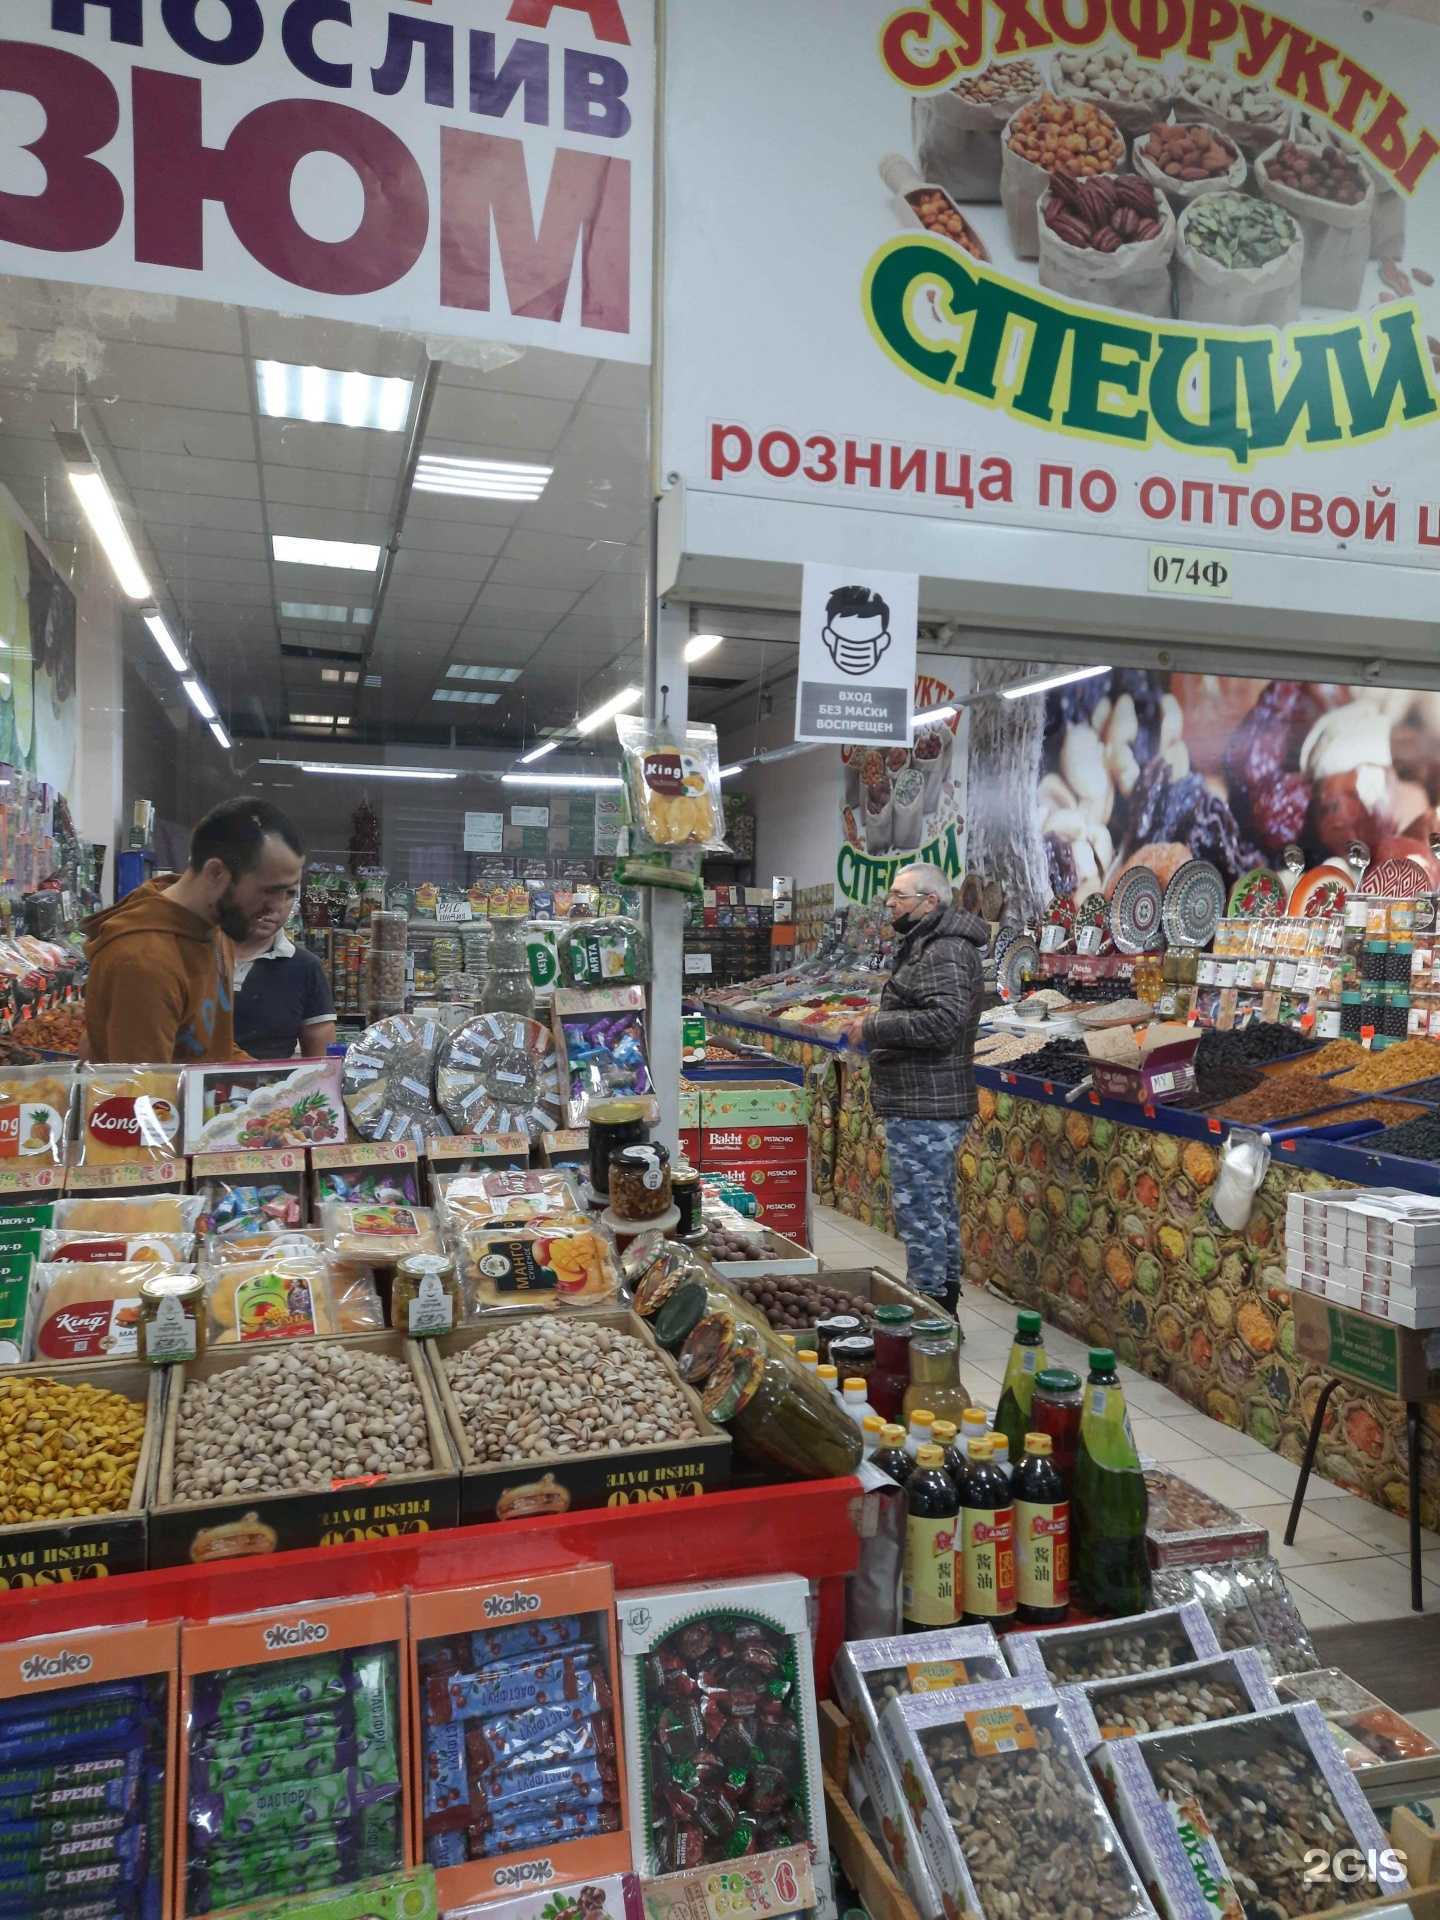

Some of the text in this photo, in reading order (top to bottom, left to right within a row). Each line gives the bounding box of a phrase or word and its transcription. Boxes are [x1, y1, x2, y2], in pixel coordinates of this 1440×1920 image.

[884, 0, 1440, 188] СУХОФРУКТЫ
[870, 244, 1438, 464] СПЕЦИИ
[709, 421, 1013, 510] розница
[1039, 464, 1117, 514] по
[1138, 476, 1397, 543] оптовой
[1153, 556, 1228, 588] 074Ф
[839, 691, 873, 704] ВХОД
[818, 704, 888, 718] БЕЗ МАСКИ
[816, 719, 893, 734] ВОСПРЕЩЕН
[646, 763, 681, 779] King
[589, 943, 600, 973] МЯТА
[709, 1133, 743, 1145] Bakht
[721, 1170, 746, 1182] akht
[510, 1242, 529, 1290] МАНГО
[56, 1313, 106, 1333] King
[606, 1463, 704, 1487] FRESH DATE
[374, 1499, 430, 1519] FRESH
[43, 1541, 109, 1564] FRESH
